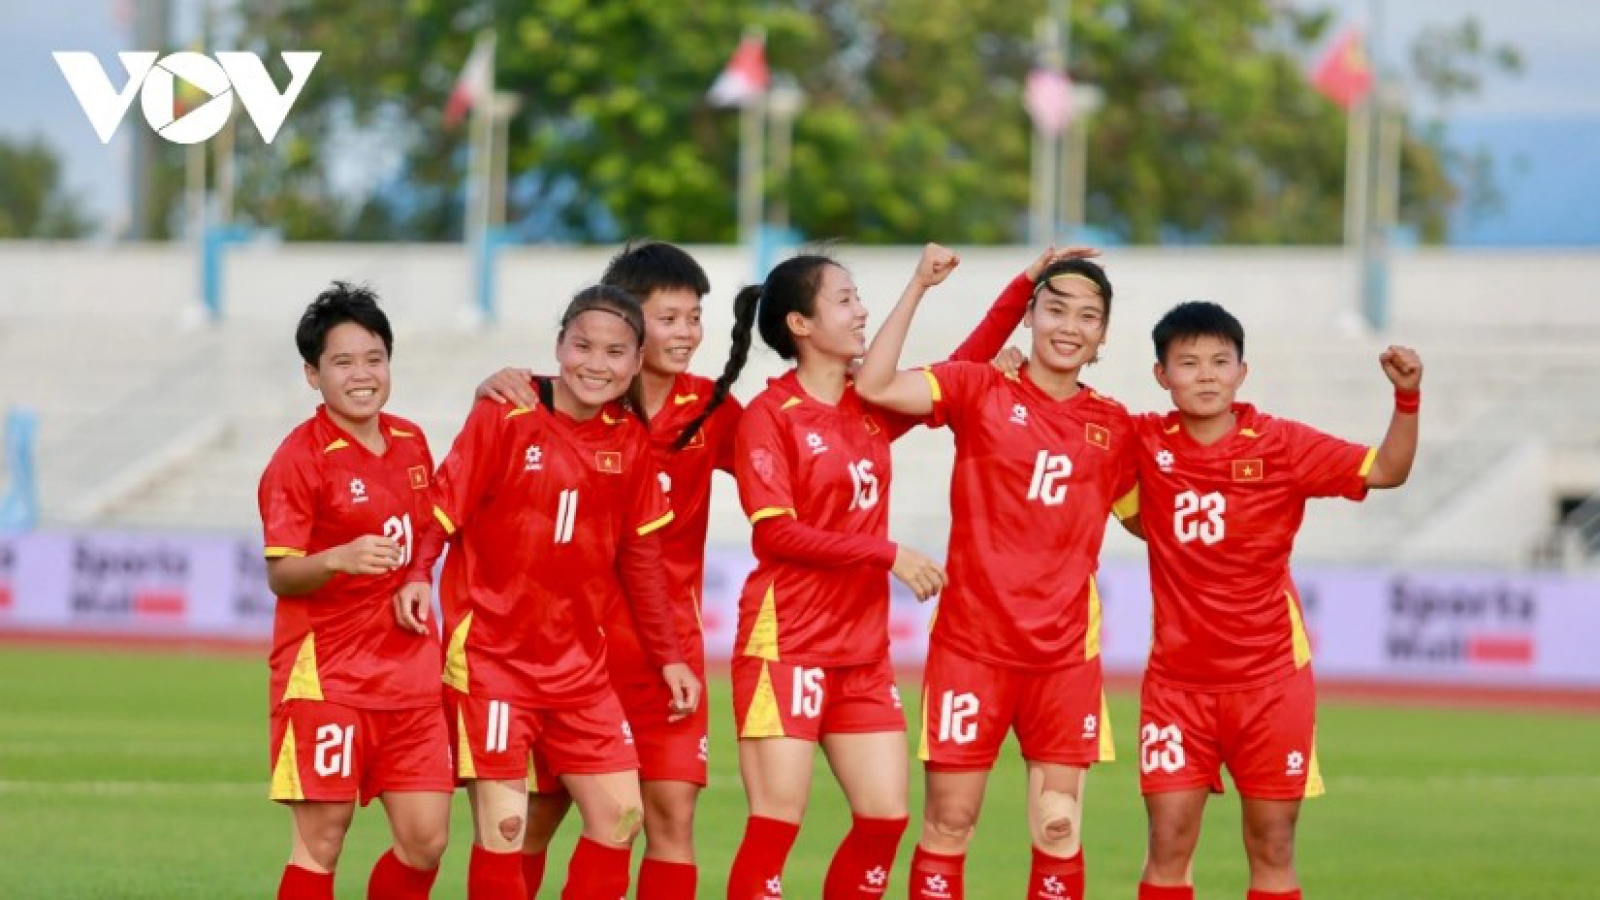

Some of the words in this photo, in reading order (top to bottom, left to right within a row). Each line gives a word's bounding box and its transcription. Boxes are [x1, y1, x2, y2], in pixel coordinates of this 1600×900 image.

[847, 458, 879, 511] 15
[1027, 449, 1073, 505] 12
[554, 489, 578, 544] 11
[1174, 490, 1226, 545] 23
[791, 666, 825, 719] 15
[938, 690, 980, 744] 12
[314, 723, 354, 777] 21
[486, 699, 510, 753] 11
[1141, 722, 1186, 774] 23
